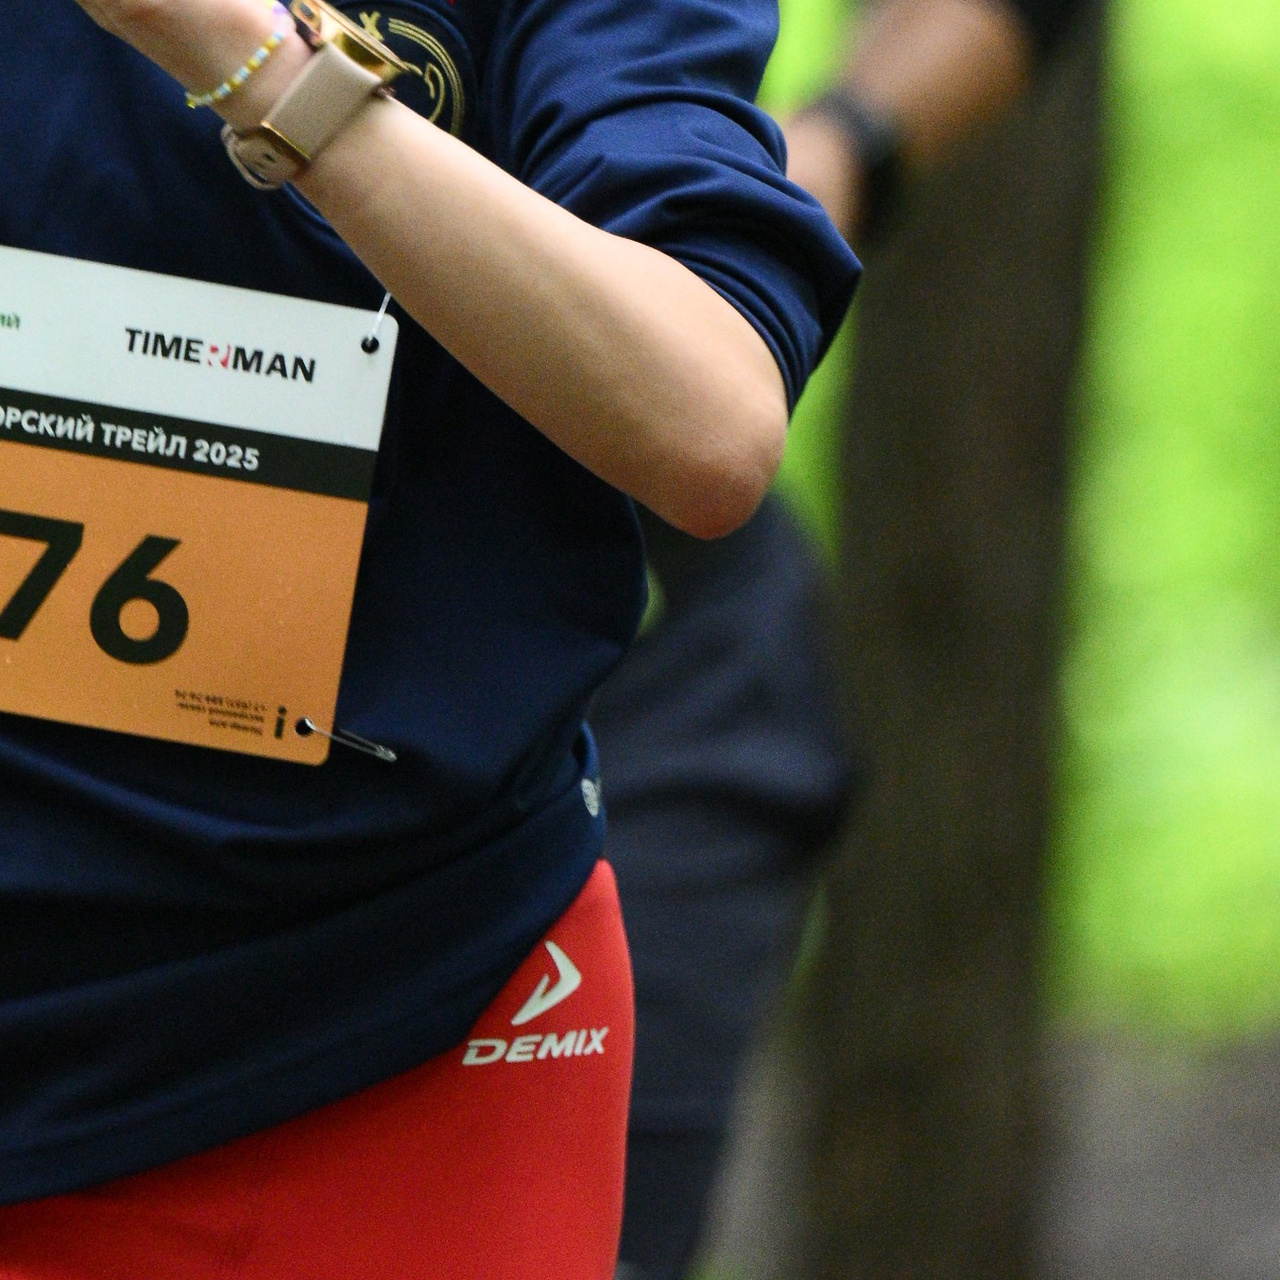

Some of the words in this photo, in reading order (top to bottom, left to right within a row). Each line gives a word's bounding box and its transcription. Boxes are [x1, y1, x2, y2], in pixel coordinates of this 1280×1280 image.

[100, 422, 187, 460] ТРЕЙЛ
[192, 437, 261, 472] 2025
[461, 1026, 610, 1066] DEMIX
